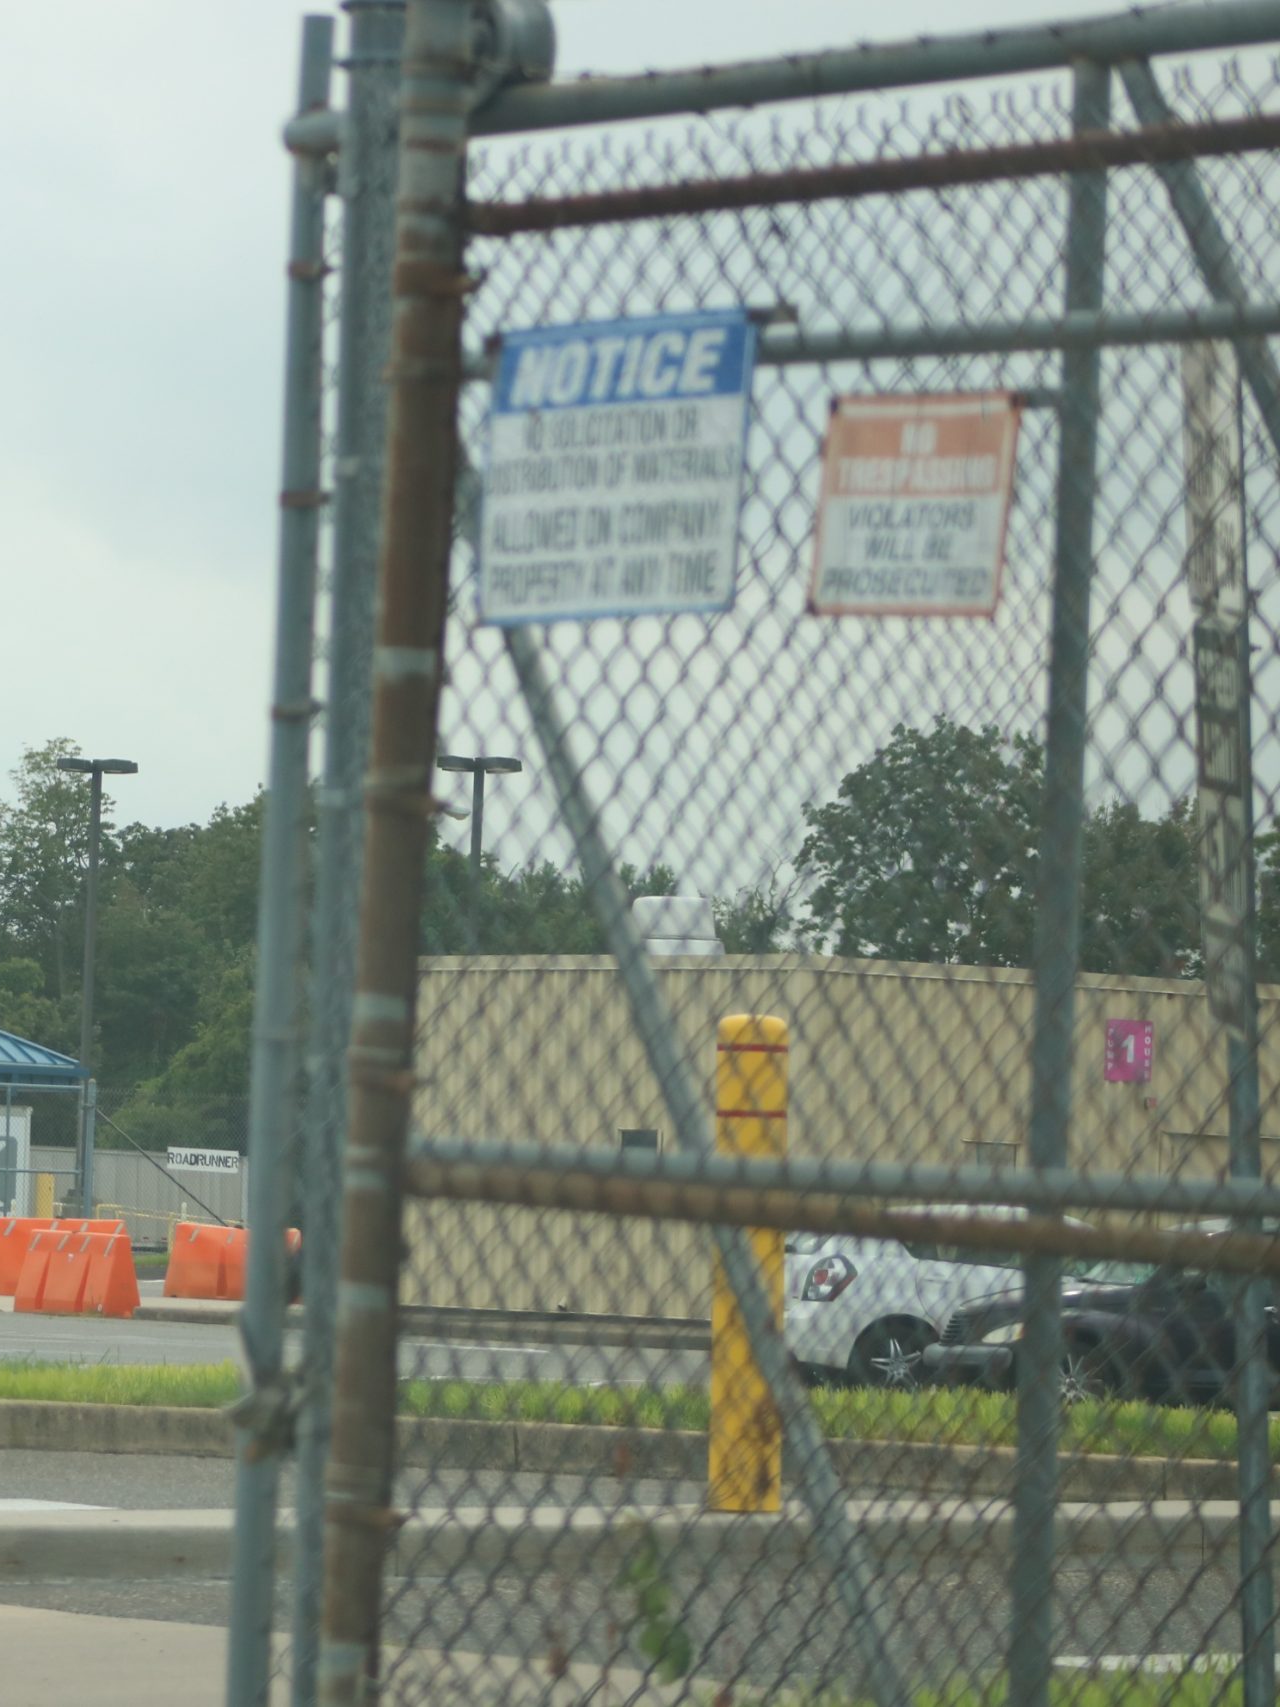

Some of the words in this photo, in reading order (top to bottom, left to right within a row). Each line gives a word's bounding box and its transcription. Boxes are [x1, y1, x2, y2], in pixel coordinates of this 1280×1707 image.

[510, 328, 727, 407] NOTICE
[551, 409, 665, 449] SOLICITATION
[673, 405, 697, 441] OR
[489, 455, 597, 496] DISTRIBUTION
[606, 451, 624, 488] OF
[634, 444, 734, 484] MATERIALS
[494, 506, 577, 554] ALLOWED
[585, 504, 610, 548] ON
[620, 499, 719, 546] COMPANY
[849, 503, 975, 531] VIOLATORS
[866, 534, 912, 562] WILL
[923, 532, 953, 561] BE
[491, 560, 584, 605] PROPERTY
[593, 555, 614, 598] AT
[621, 554, 659, 597] ANY
[669, 549, 716, 595] TIME
[821, 566, 989, 598] PROSECUTED
[1122, 1034, 1135, 1063] 1
[167, 1152, 238, 1168] ROADRUNNER
